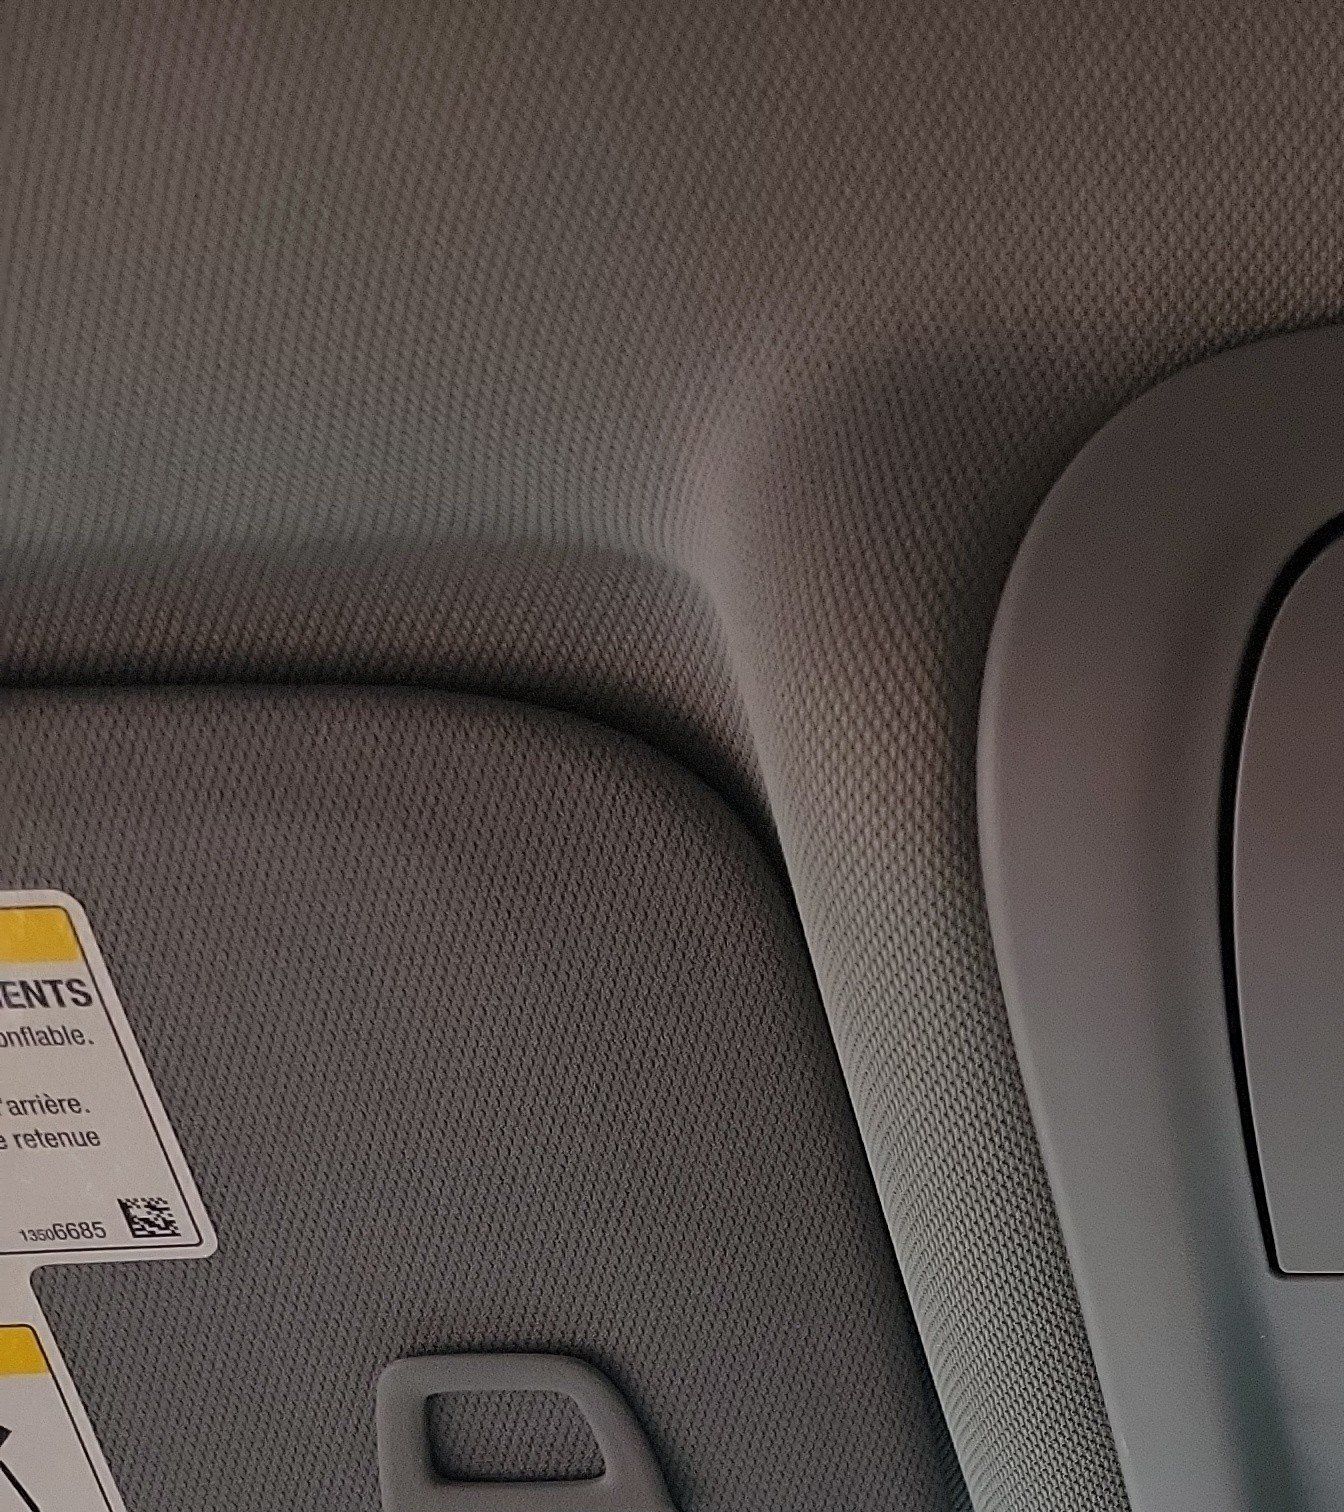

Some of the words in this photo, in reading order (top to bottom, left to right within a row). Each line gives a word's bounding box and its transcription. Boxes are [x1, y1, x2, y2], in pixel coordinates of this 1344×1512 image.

[0, 978, 93, 1008] ENTS
[13, 1128, 101, 1149] retenue
[19, 1221, 107, 1241] 13506685
